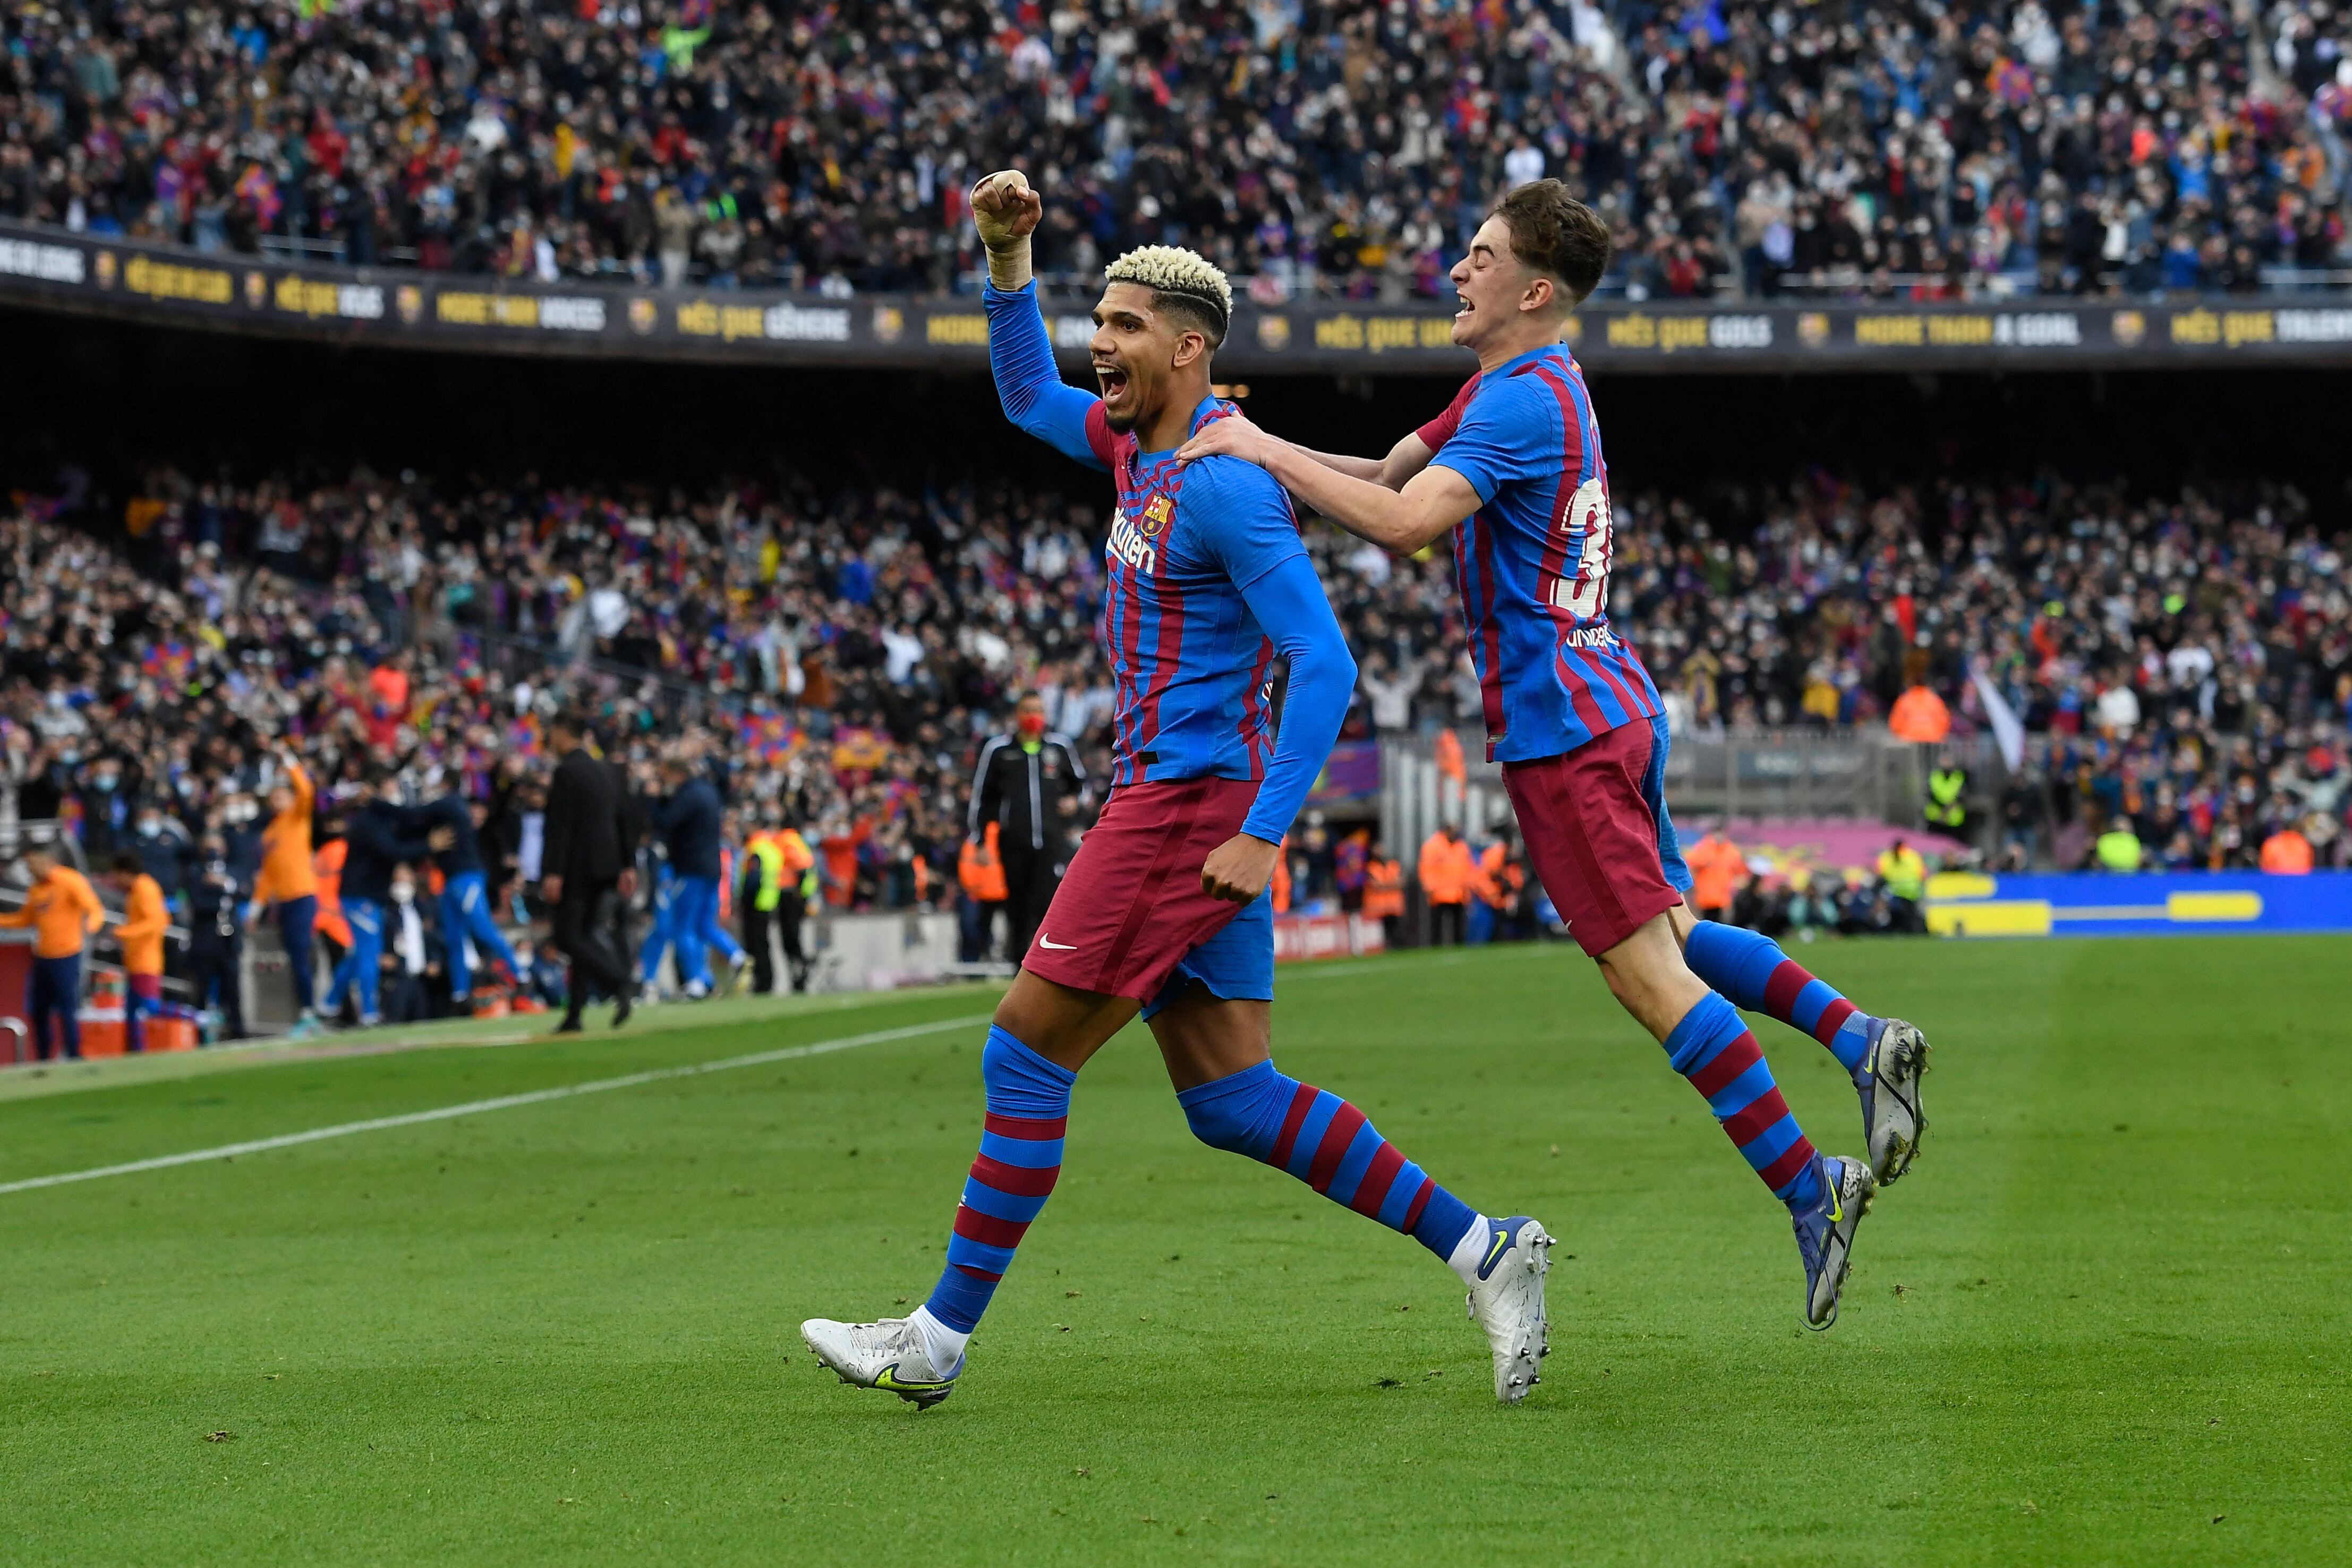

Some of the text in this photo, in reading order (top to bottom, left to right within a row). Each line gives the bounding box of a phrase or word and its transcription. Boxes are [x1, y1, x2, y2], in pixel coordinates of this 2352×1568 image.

[1316, 312, 1364, 349] MÉS
[1366, 317, 1416, 354] QUE
[1607, 311, 1656, 348] MÉS
[1658, 316, 1708, 354] QUE
[2171, 306, 2220, 344] MÉS
[2222, 309, 2273, 349] QUE
